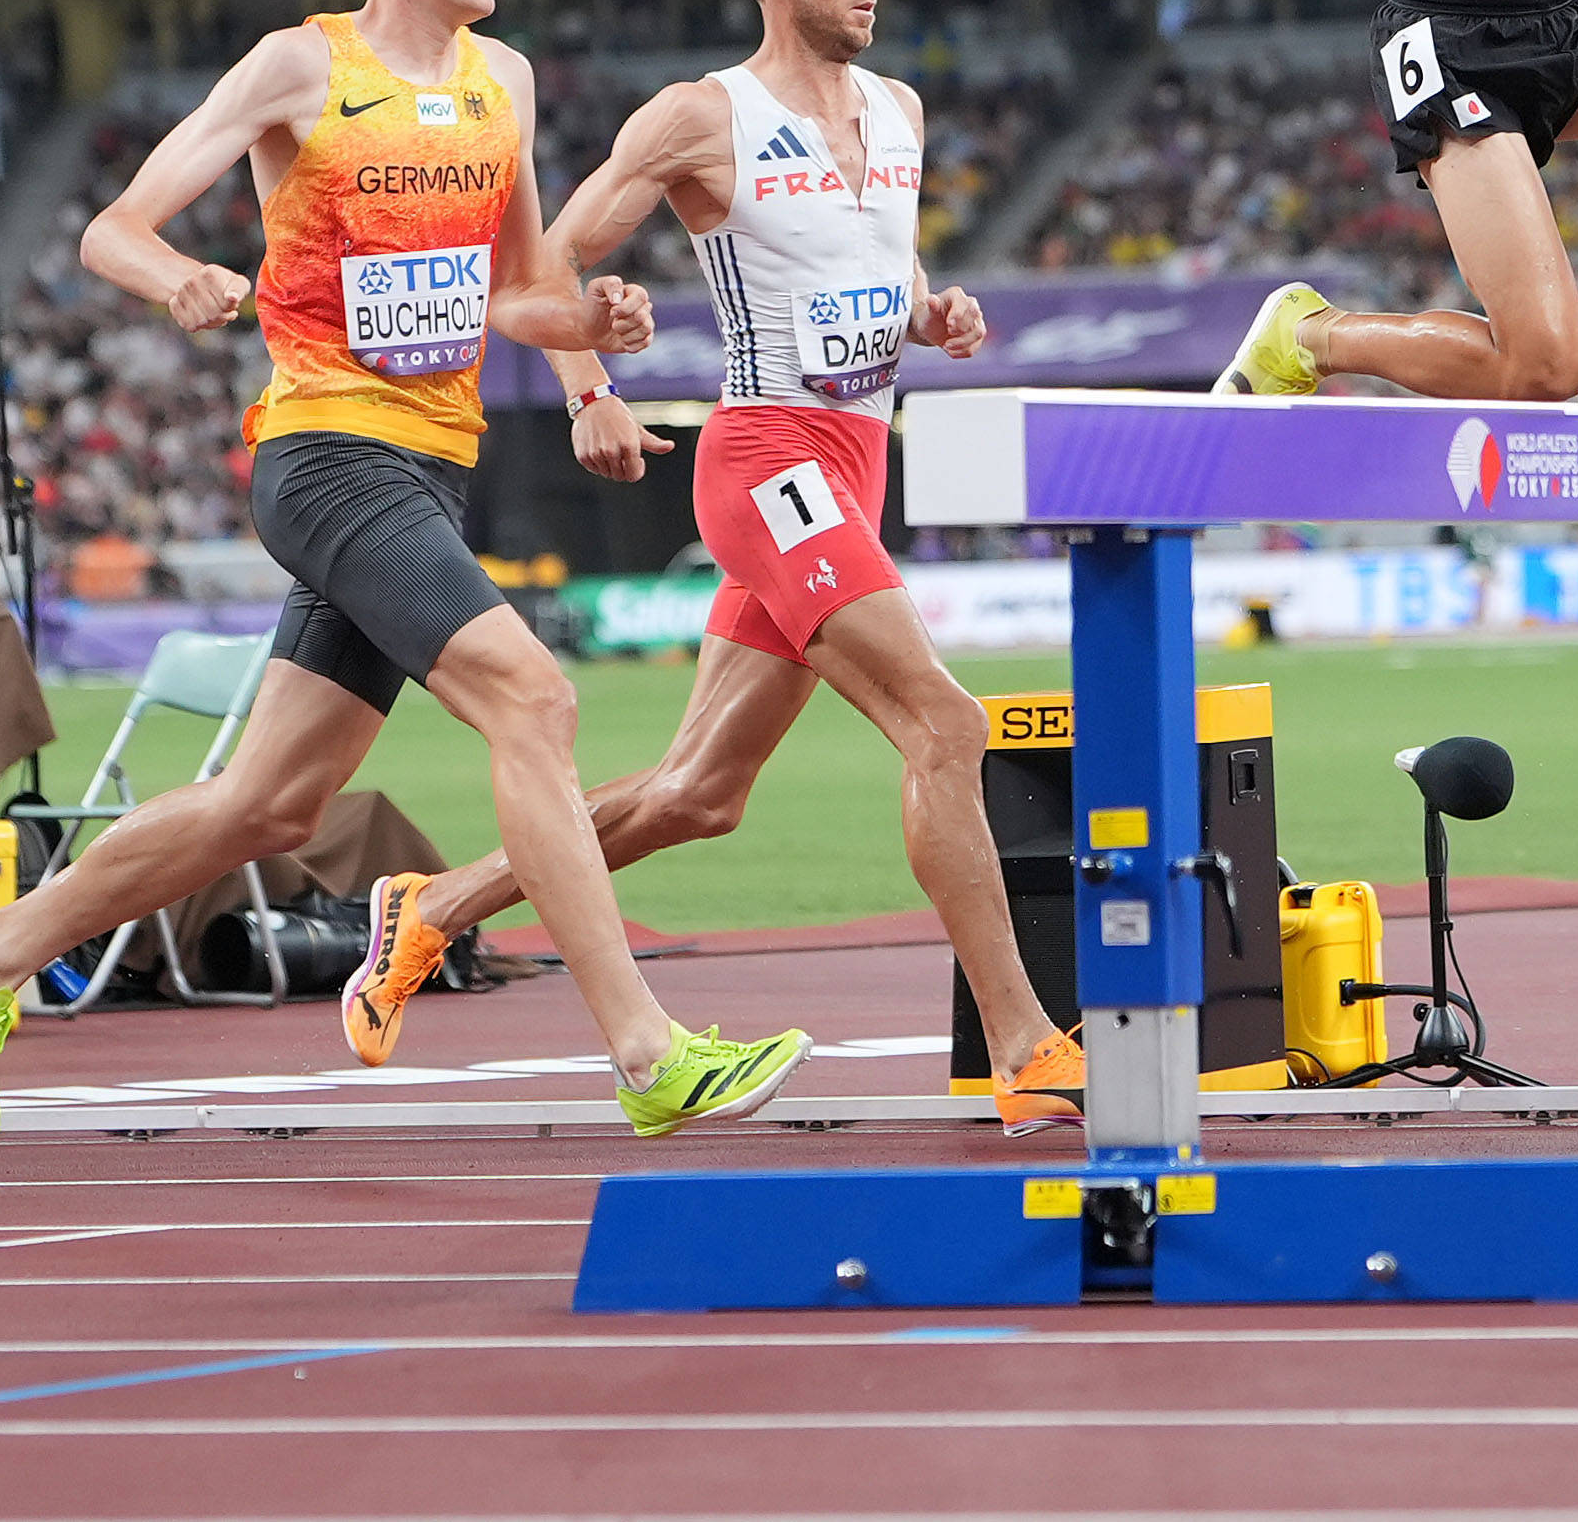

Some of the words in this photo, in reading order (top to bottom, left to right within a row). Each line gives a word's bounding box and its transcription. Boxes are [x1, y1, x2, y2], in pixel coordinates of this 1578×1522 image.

[1397, 41, 1422, 96] 6
[417, 102, 452, 117] WGV
[357, 162, 500, 195] GERMANY
[391, 252, 482, 292] TDK
[356, 294, 484, 341] BUCHHOLZ
[839, 281, 909, 321] TDK
[822, 324, 903, 368] DARU
[1506, 433, 1535, 453] WORLD
[1536, 433, 1578, 453] ATHLETICS
[779, 481, 814, 528] 1
[1001, 706, 1074, 740] SE
[376, 880, 413, 976] NITRO
